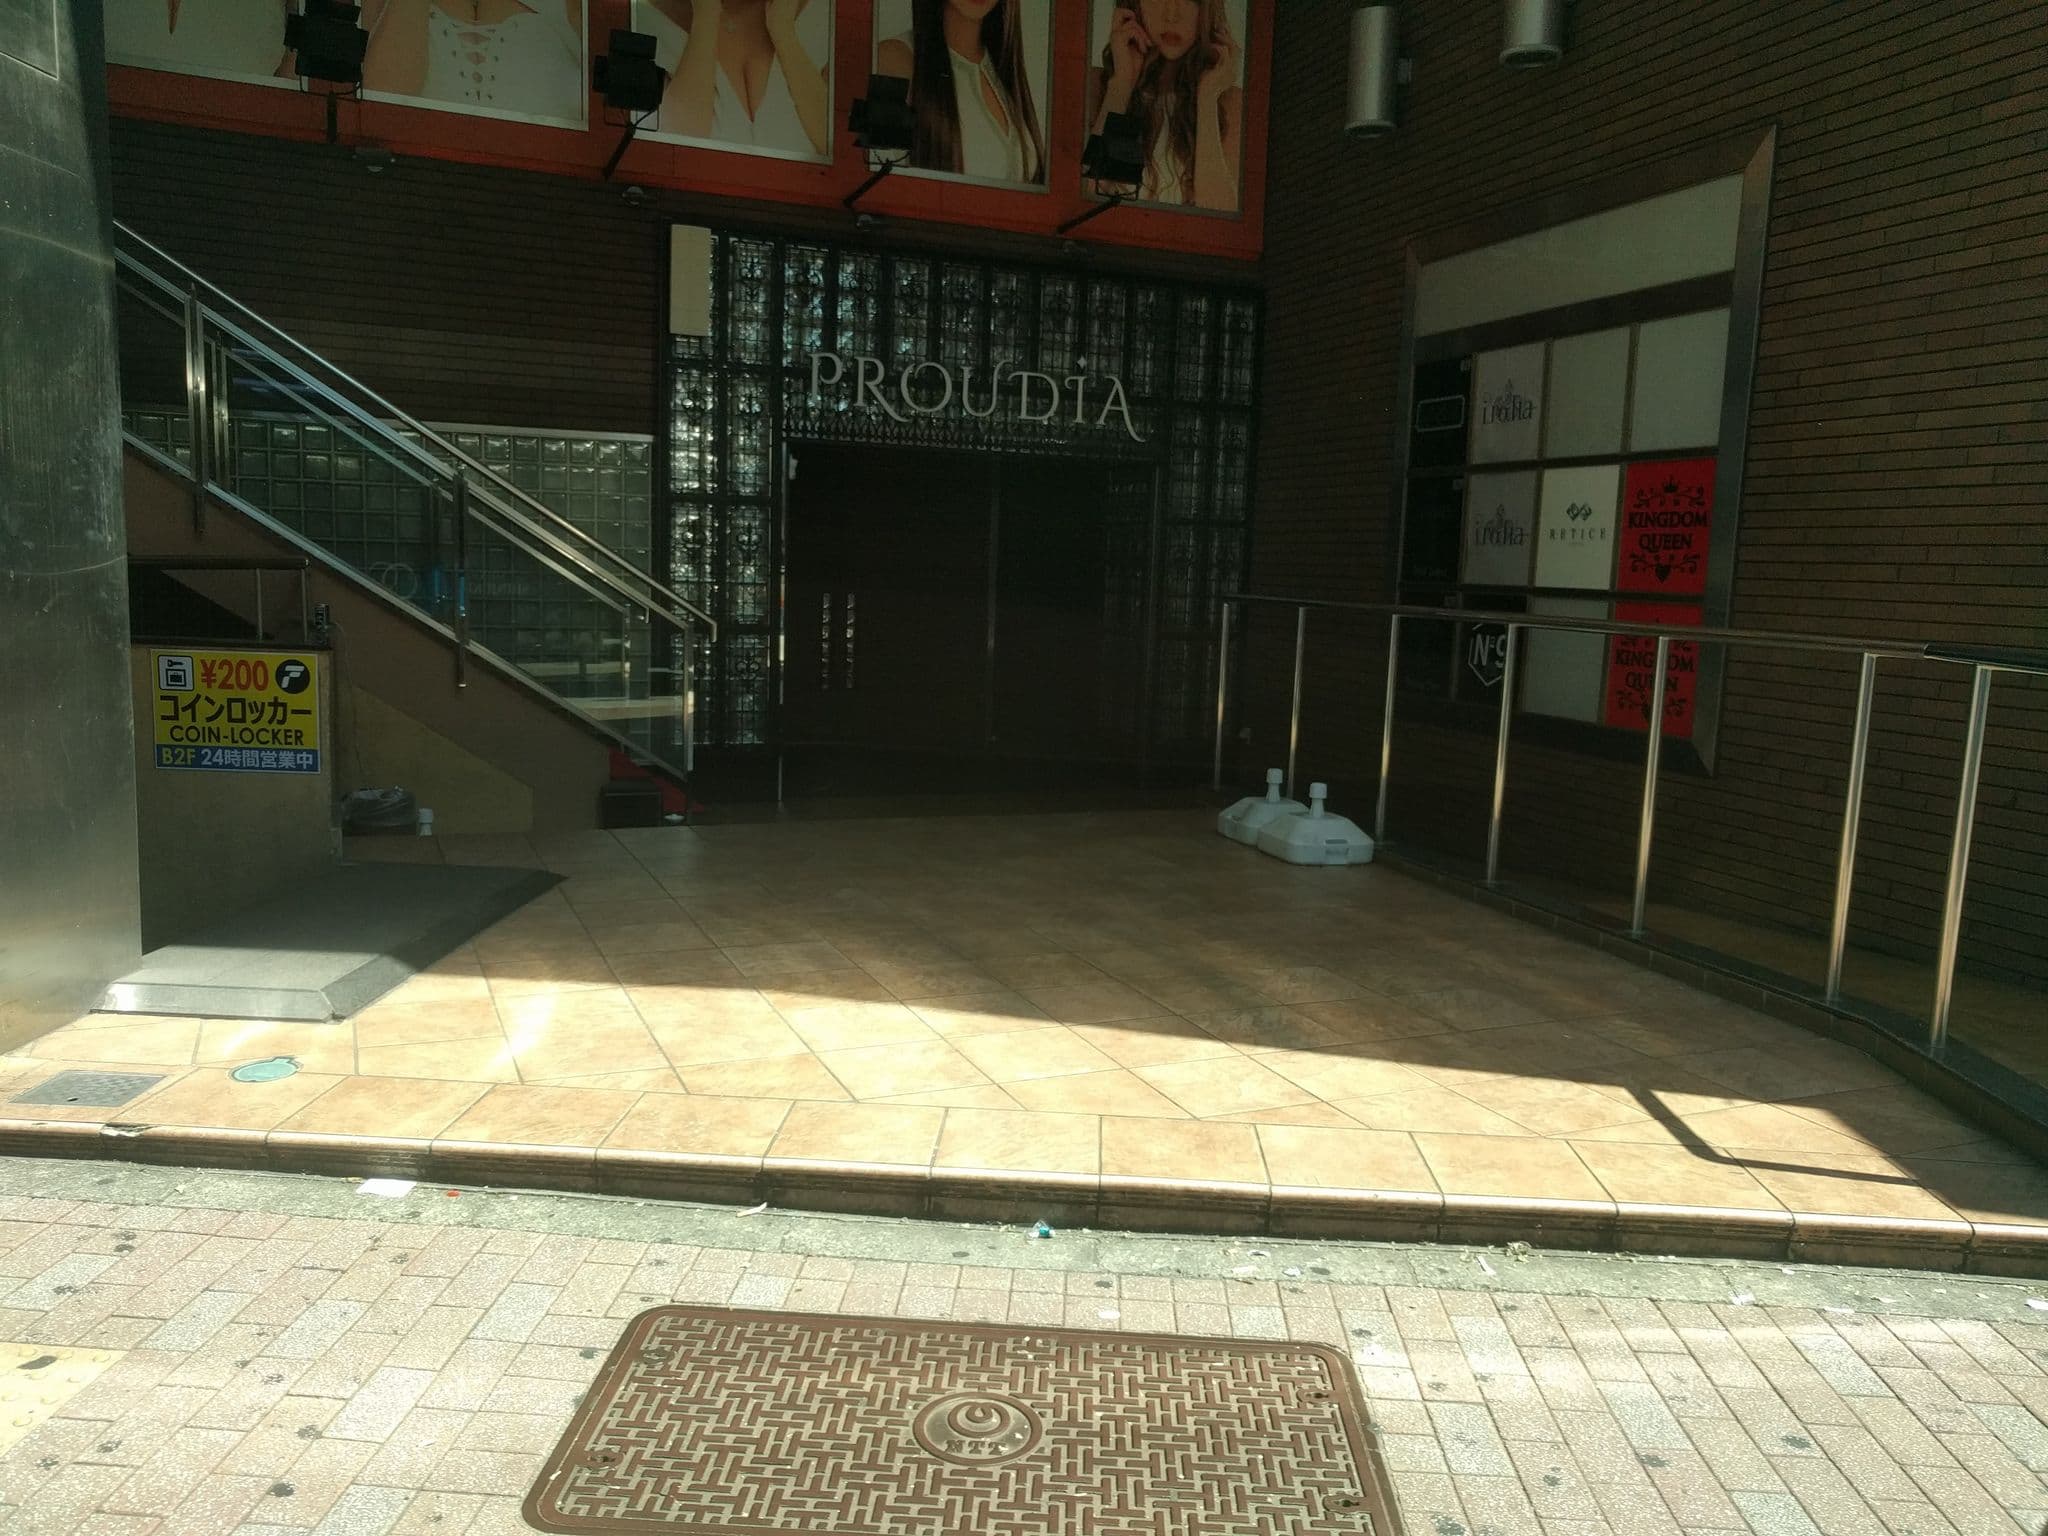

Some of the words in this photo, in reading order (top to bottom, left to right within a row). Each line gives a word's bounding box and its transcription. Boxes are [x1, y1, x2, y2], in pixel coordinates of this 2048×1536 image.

[808, 352, 1147, 443] PROUDIA
[1628, 511, 1708, 529] KINGDOM
[1639, 533, 1693, 553] QUEEN
[1616, 649, 1695, 673] KINGOM
[200, 658, 269, 691] ¥200
[160, 693, 312, 725] コインロッカー
[170, 725, 304, 745] COIN-LOCKER
[162, 747, 196, 766] B2F
[201, 748, 313, 769] 24時間営業中
[946, 1439, 1006, 1455] NTT
